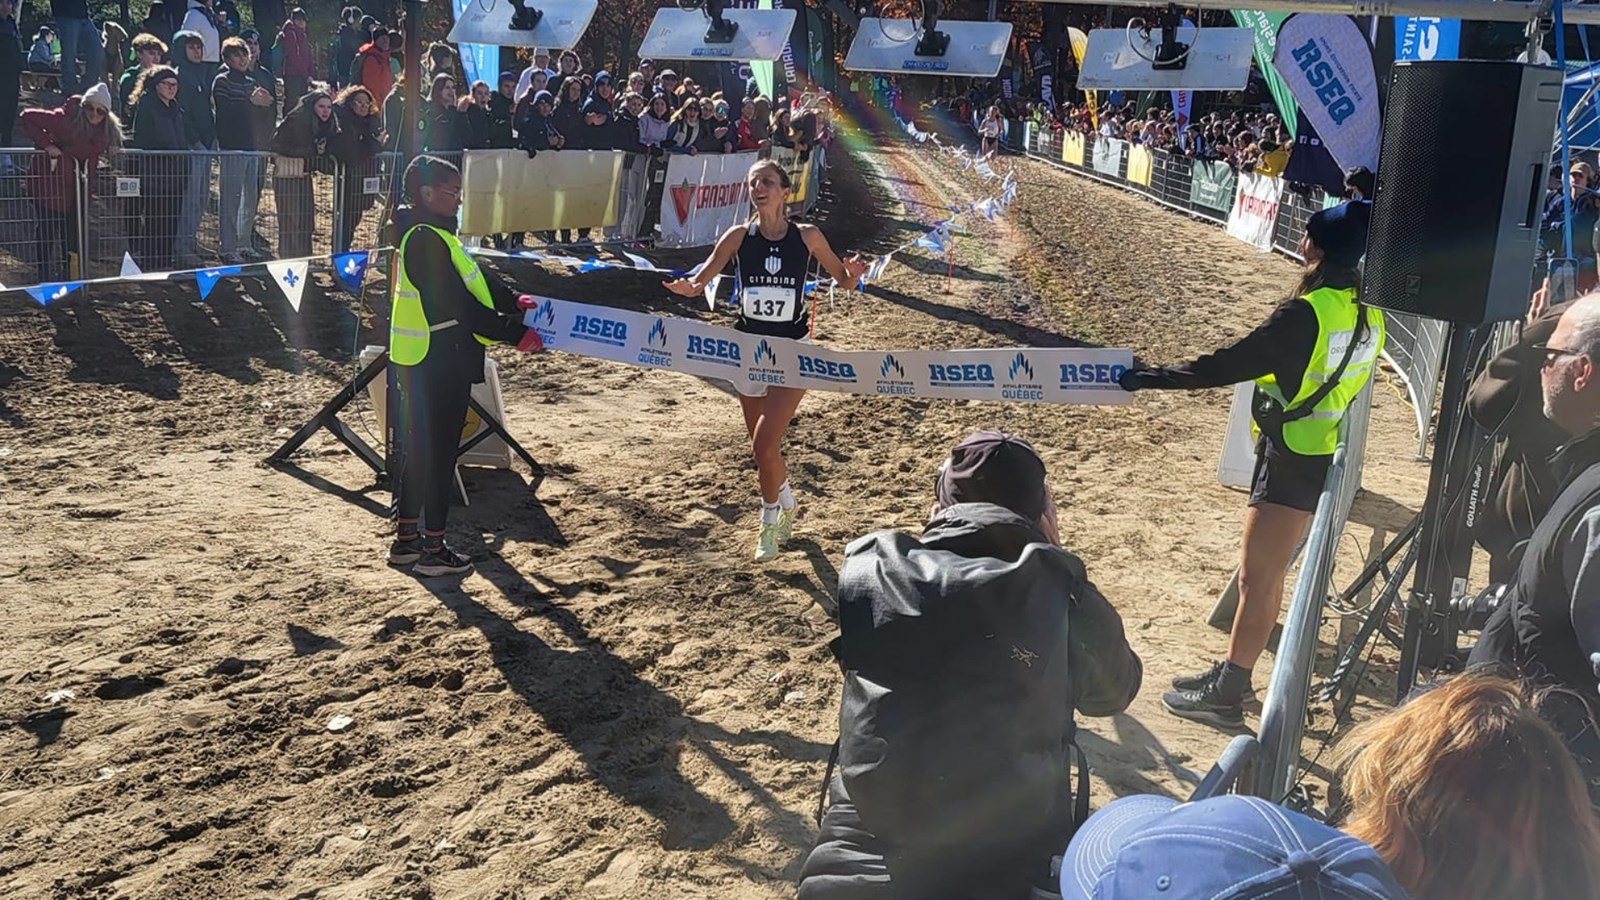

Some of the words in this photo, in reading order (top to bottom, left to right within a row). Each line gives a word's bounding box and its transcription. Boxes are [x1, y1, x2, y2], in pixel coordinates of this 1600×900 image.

[1292, 38, 1355, 125] RSEQ
[749, 275, 796, 285] CITADINS
[752, 299, 785, 317] 137
[572, 315, 627, 340] RSEQ
[687, 335, 741, 360] RSEQ
[638, 353, 672, 367] QUÉBEC
[798, 355, 857, 378] RSEQ
[748, 372, 786, 384] QUÉBEC
[928, 364, 994, 381] RSEQ
[1060, 364, 1127, 383] RSEQ
[876, 384, 916, 395] QUÉBEC
[1002, 388, 1044, 400] QUÉBEC
[1466, 489, 1479, 527] GOLIATH
